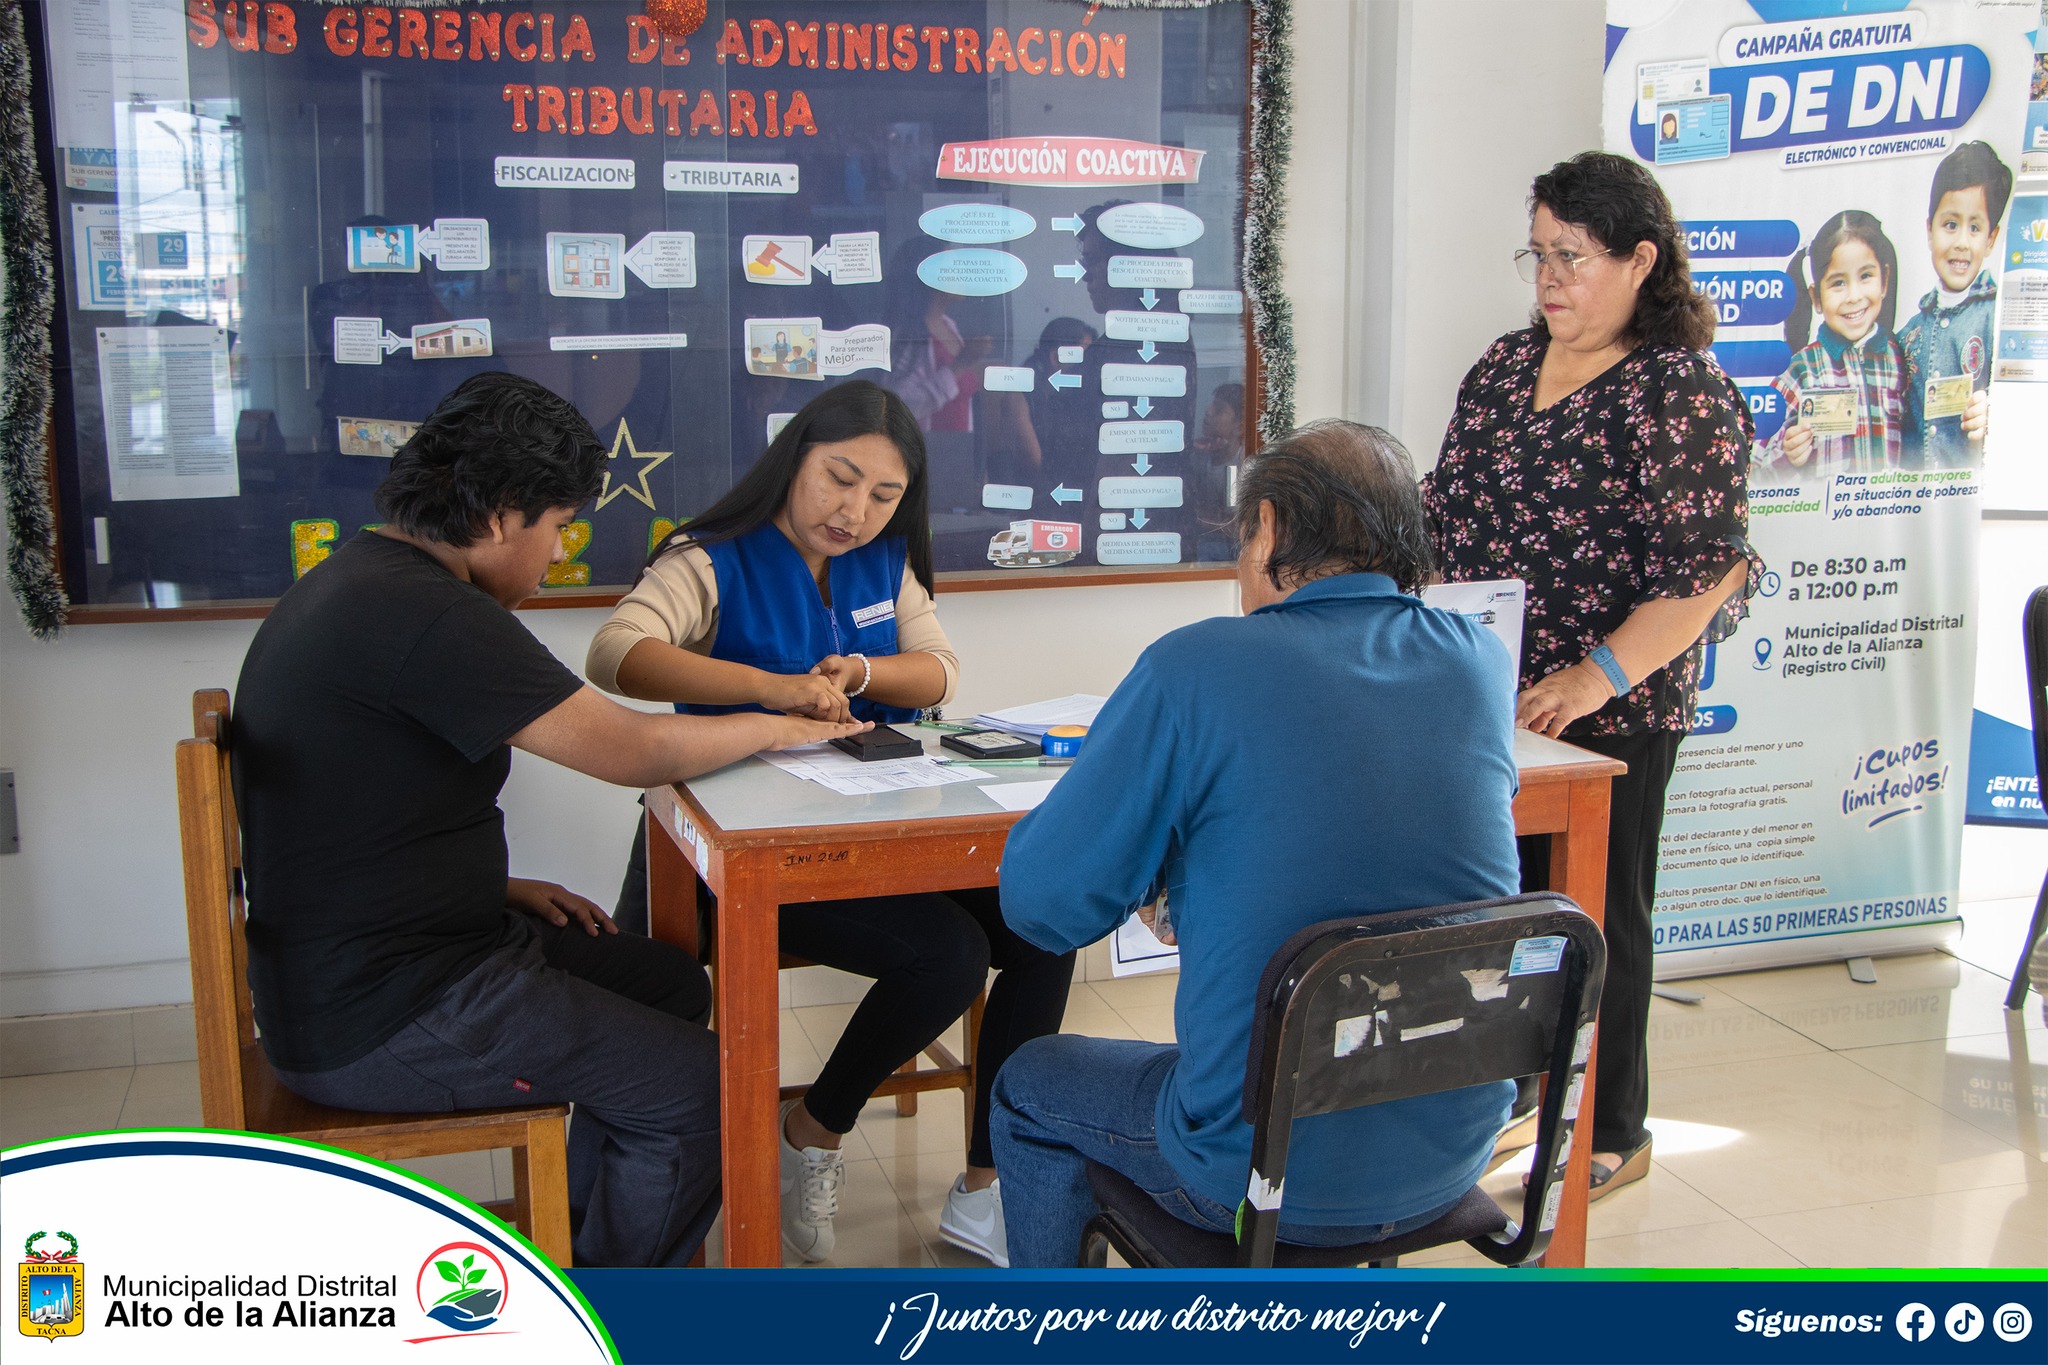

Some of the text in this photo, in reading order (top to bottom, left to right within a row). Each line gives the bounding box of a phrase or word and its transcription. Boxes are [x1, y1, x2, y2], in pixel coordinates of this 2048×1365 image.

[188, 0, 298, 54] SUB
[323, 7, 596, 63] GERENCIA
[716, 4, 1127, 79] ADMINISTRACIÓN
[1736, 23, 1912, 59] CAMPAÑA GRATUITA
[1740, 56, 1963, 140] DE DNI
[503, 83, 819, 138] TRIBUTARIA
[953, 141, 1187, 177] EJECUCIÓN COACTIVA
[1785, 136, 1946, 165] ELECTRÓNICO Y CONVENCIONAL
[501, 164, 631, 185] FISCALIZACION
[680, 169, 783, 188] TRIBUTARIA
[945, 219, 1000, 227] PROCEDIMIENTO
[163, 238, 184, 253] 29
[1682, 226, 1736, 251] CIÓN
[1691, 276, 1784, 300] CIÓN POR
[1115, 316, 1160, 324] NOTIFICACION
[844, 334, 883, 345] Preparados
[825, 353, 864, 366] Mejor...
[1835, 470, 1972, 487] Para adultos mayores
[1747, 485, 1800, 499] ersonas
[1834, 484, 1979, 502] en situación de pobreza
[1749, 500, 1820, 516] capacidad
[1832, 504, 1921, 521] y/o abandono
[1041, 525, 1074, 533] EMBARGOS
[1790, 557, 1906, 578] De 8:30 a.m
[1788, 580, 1898, 601] a 12:00 p.m
[1785, 614, 1964, 640] Municipalidad Distrital
[1783, 637, 1923, 659] Alto de la Alianza
[1782, 656, 1886, 678] (Registro Civil)
[1693, 711, 1714, 728] OS
[1678, 740, 1804, 760] presencia del menor y uno
[1854, 739, 1938, 780] ¡Cupos
[1675, 758, 1757, 773] como declarante.
[1669, 779, 1813, 801] con fotografía actual, personal
[1842, 765, 1948, 815] limitados!
[1986, 775, 2039, 794] ¡ENTÉ
[1664, 796, 1787, 816] omara la fotografía gratis.
[1991, 796, 2041, 809] en nu
[1673, 833, 1688, 842] del
[1691, 829, 1741, 840] declarante
[1743, 828, 1749, 836] y
[1751, 825, 1766, 834] del
[1768, 823, 1799, 833] menor
[1662, 846, 1687, 857] tiene
[1704, 842, 1732, 853] físico,
[1756, 838, 1782, 848] copia
[1784, 834, 1815, 846] simple
[1662, 850, 1804, 871] documento que lo identifique.
[1654, 875, 1821, 899] adultos presentar DNI en físico, una
[1670, 887, 1827, 913] algún otro doc. que lo identifique.
[1669, 896, 1948, 943] PARA LAS 50 PRIMERAS PERSONAS
